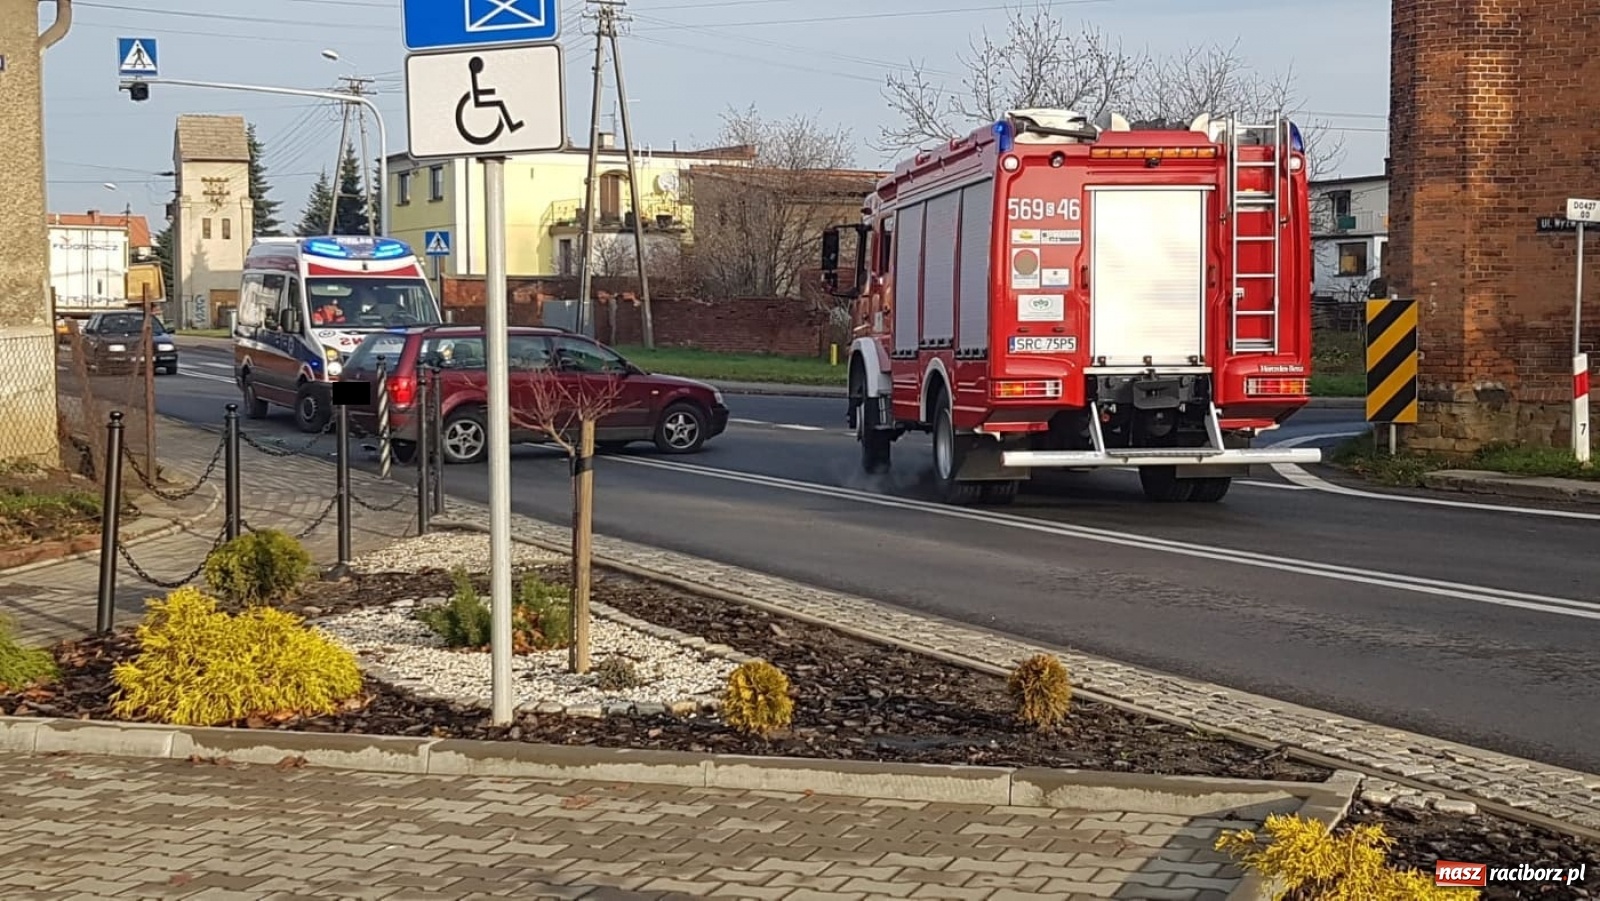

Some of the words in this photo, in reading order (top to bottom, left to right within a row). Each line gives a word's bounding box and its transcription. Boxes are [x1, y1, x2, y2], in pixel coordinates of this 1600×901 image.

[1008, 198, 1044, 220] 569
[1056, 198, 1080, 220] 46
[1016, 338, 1042, 350] SRC
[1046, 338, 1074, 350] 75P5
[1580, 422, 1587, 436] 7
